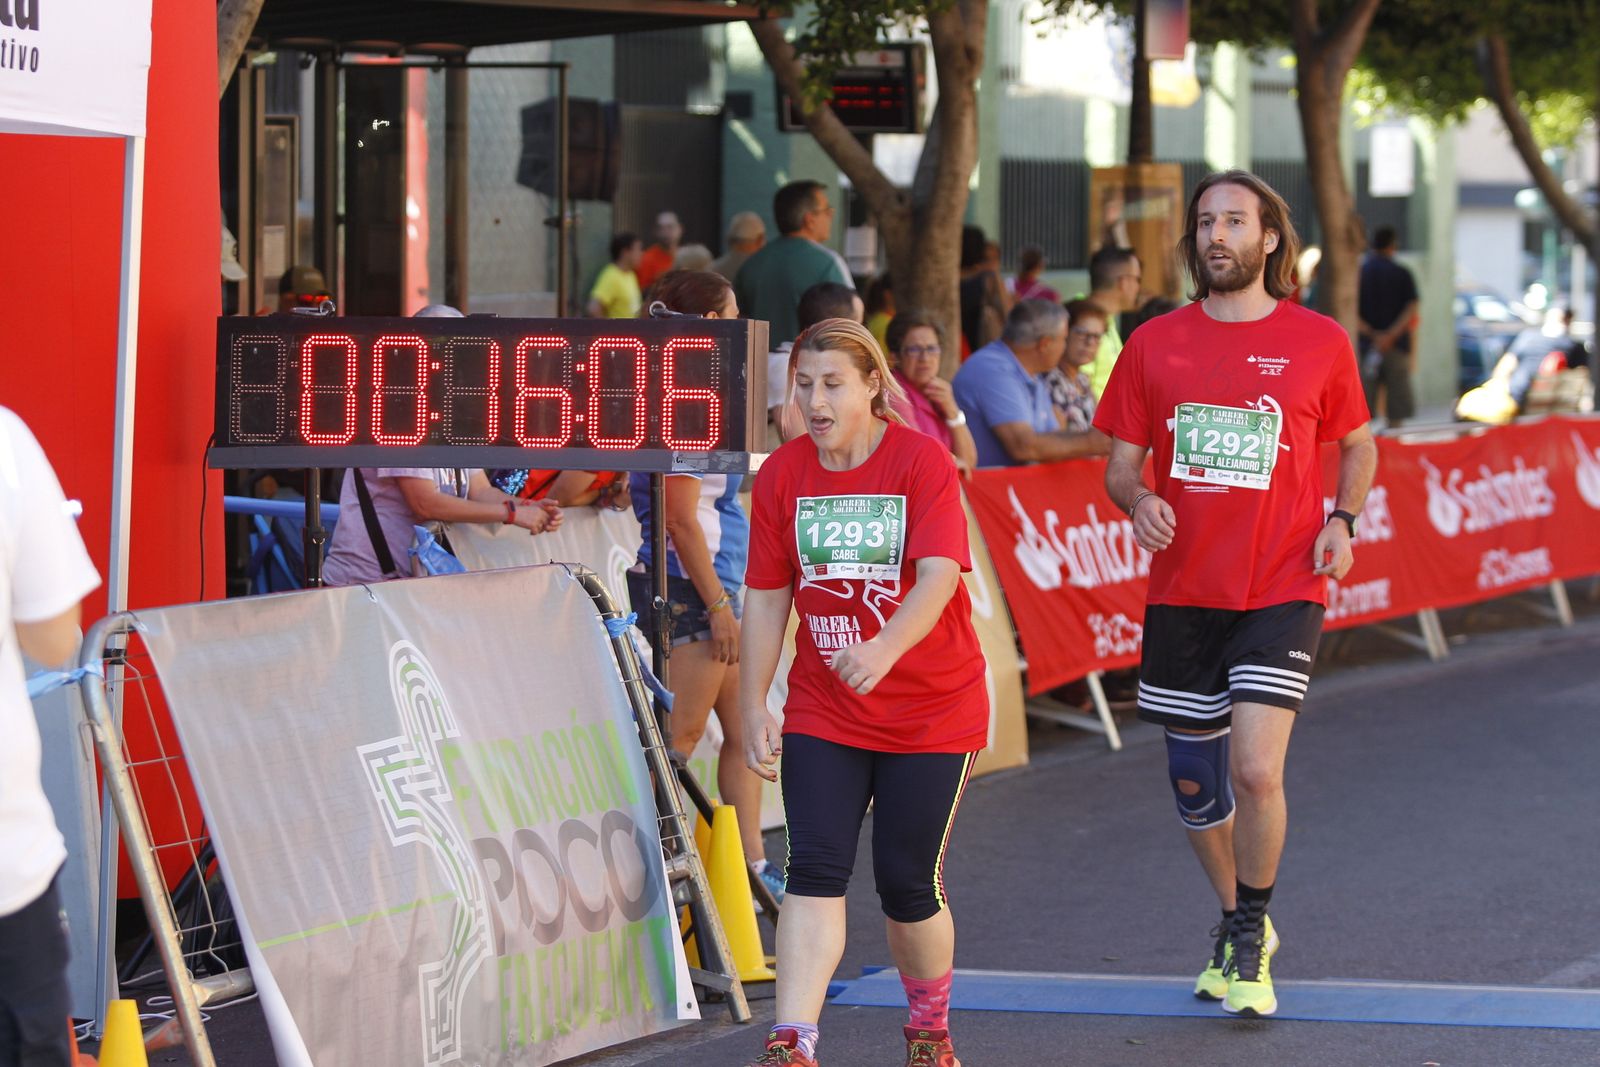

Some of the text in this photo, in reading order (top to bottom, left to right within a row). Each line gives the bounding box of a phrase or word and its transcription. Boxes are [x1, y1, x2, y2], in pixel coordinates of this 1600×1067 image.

[300, 333, 722, 451] 00:16:06
[1212, 409, 1249, 420] CARRERA
[1186, 427, 1260, 459] 1292
[1188, 453, 1216, 467] MIGUEL
[1215, 456, 1260, 472] ALEJANDRO
[833, 499, 871, 507] CARRERA
[806, 521, 885, 548] 1293
[831, 549, 860, 561] ISABEL
[805, 613, 862, 633] ARRERA
[811, 631, 863, 649] LIDARIA
[1288, 650, 1311, 663] adida
[470, 809, 664, 958] POCO
